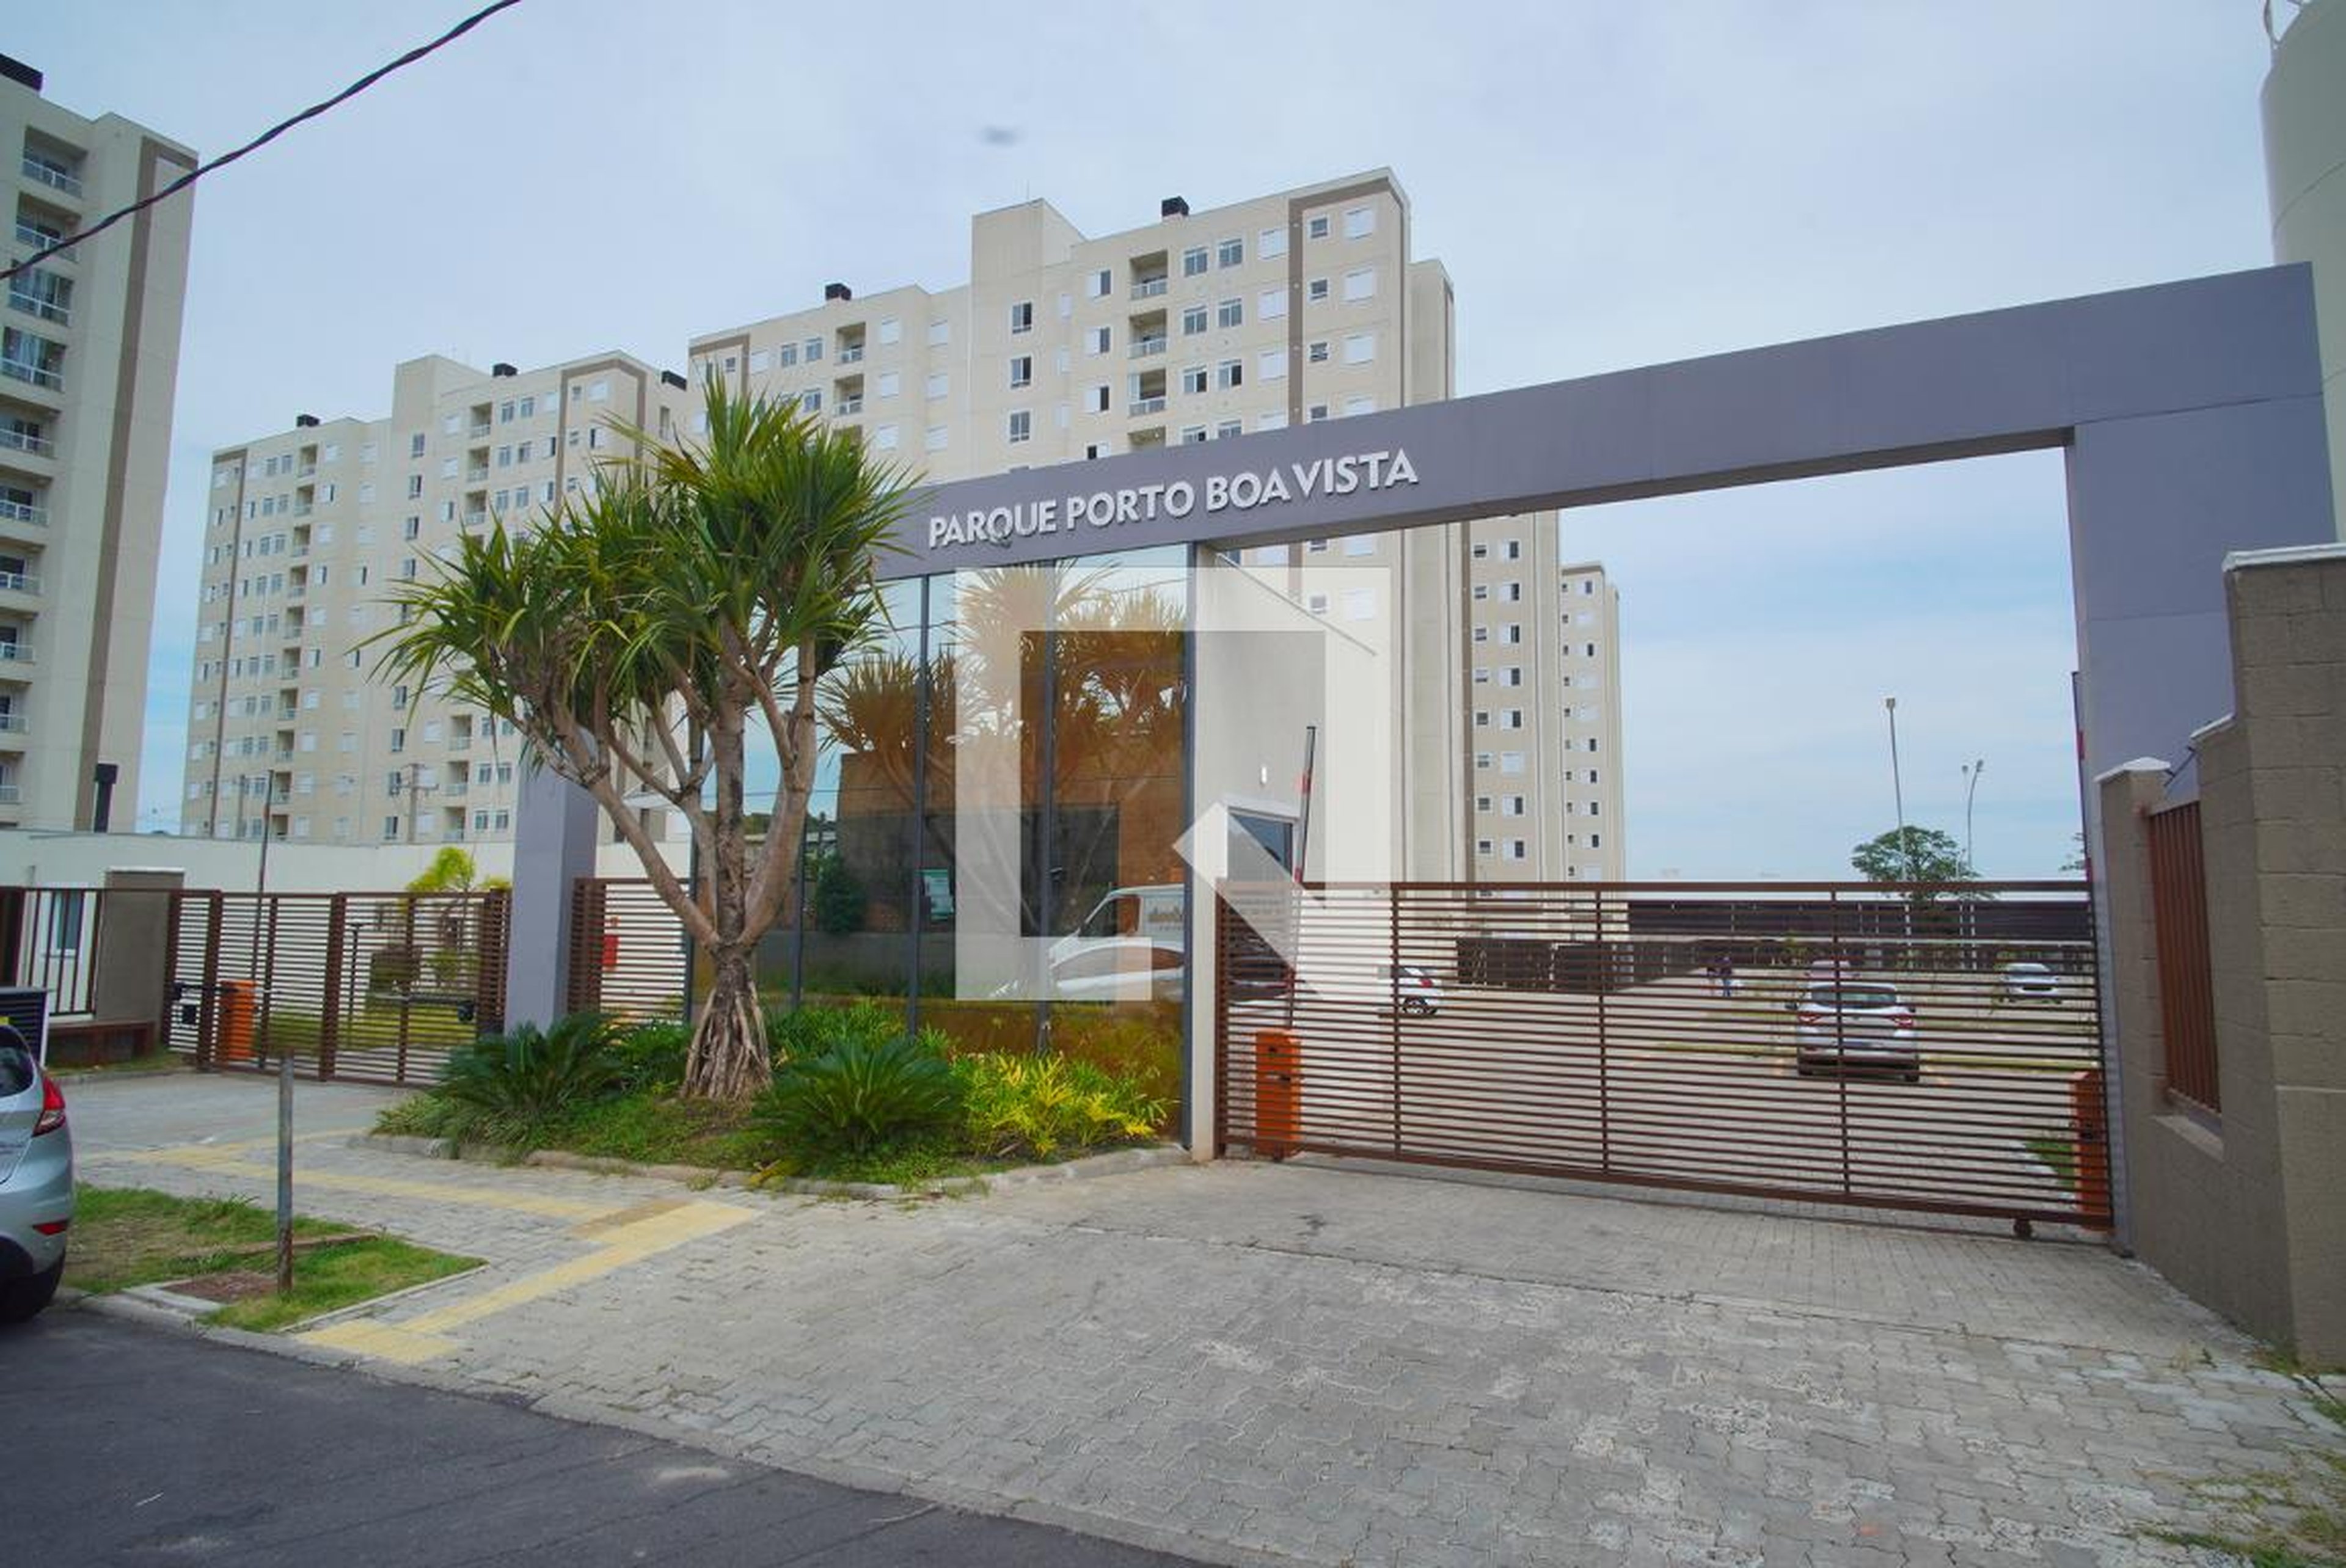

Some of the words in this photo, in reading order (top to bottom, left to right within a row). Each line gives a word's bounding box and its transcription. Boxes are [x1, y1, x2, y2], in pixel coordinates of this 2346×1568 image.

[929, 498, 1058, 549] PARQUE
[1066, 480, 1195, 530] PORTO
[1206, 467, 1291, 512] BOA
[1292, 448, 1419, 497] VISTA
